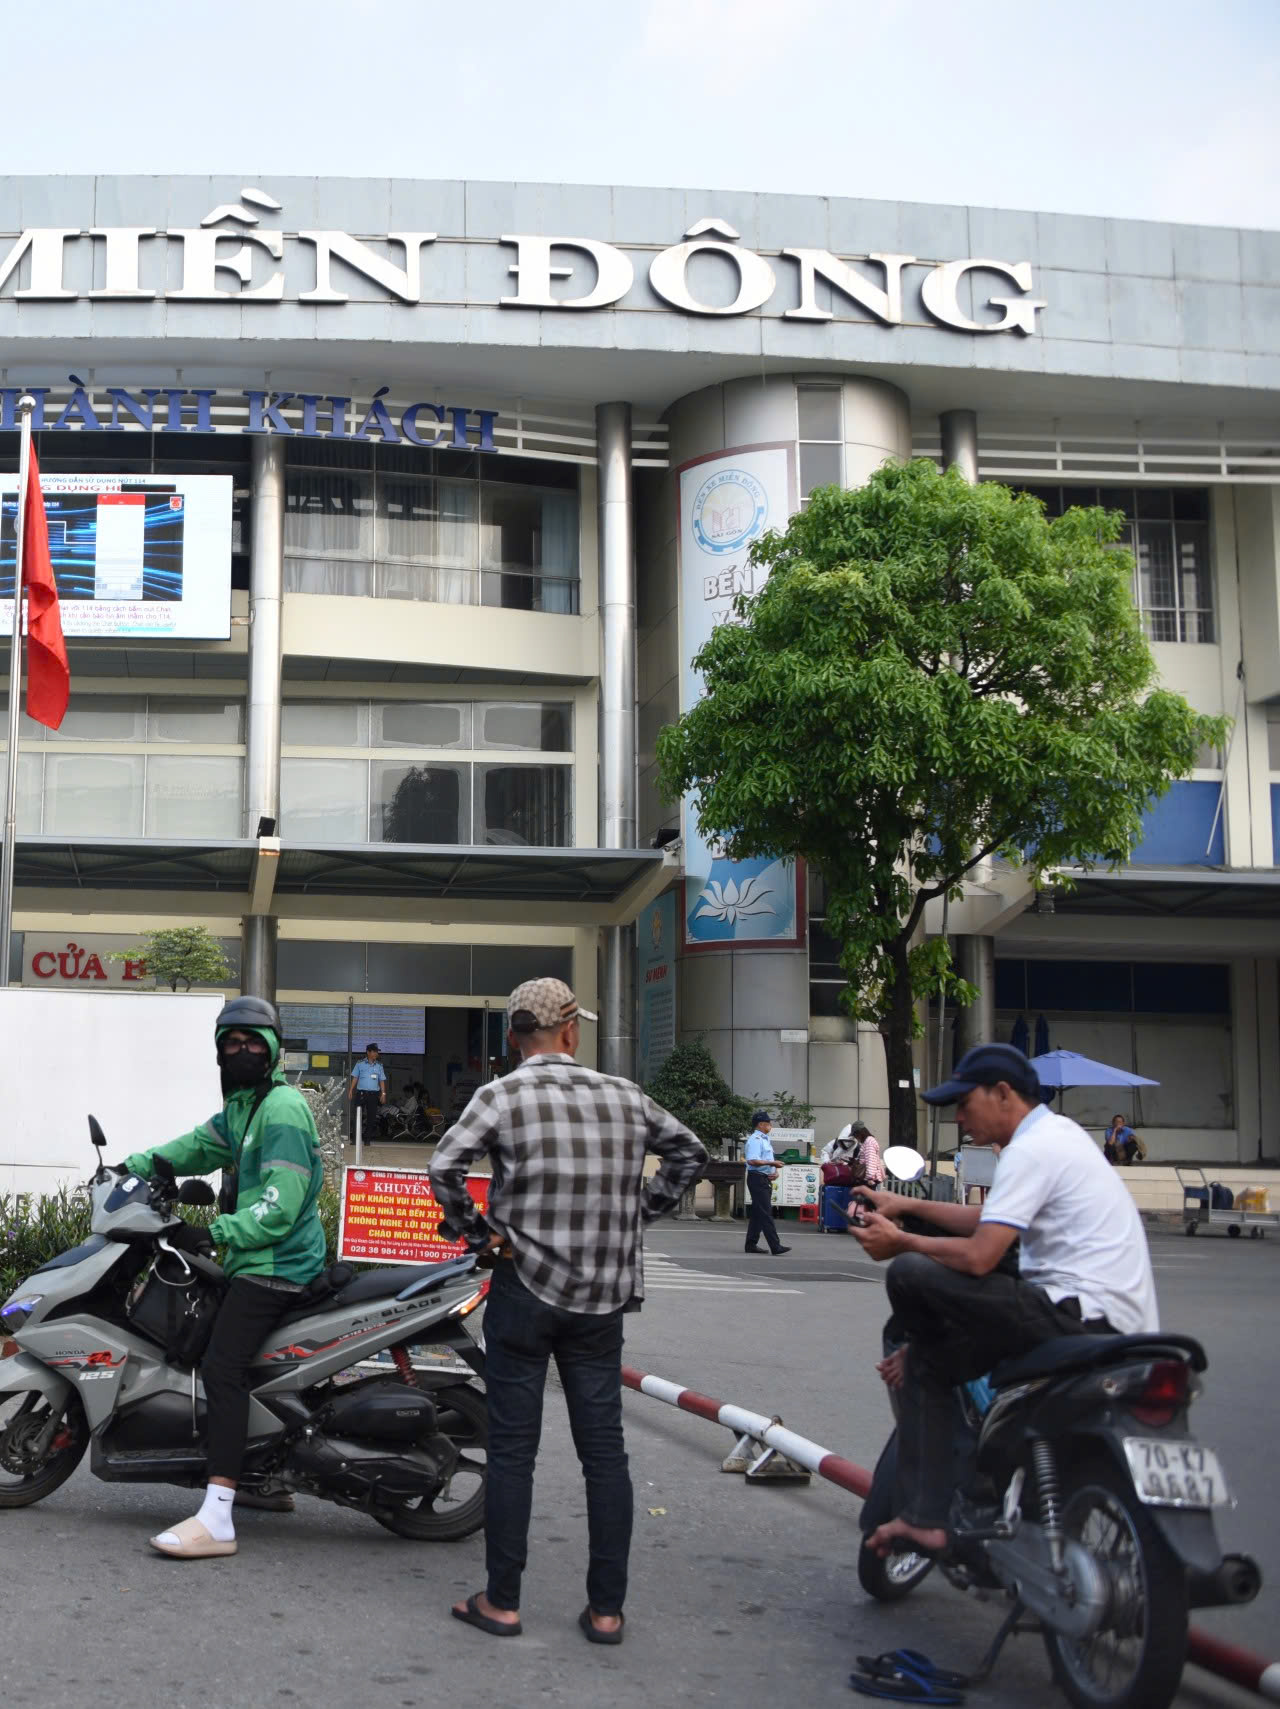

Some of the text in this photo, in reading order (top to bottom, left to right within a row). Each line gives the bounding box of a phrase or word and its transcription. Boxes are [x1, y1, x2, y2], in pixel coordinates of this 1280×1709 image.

[499, 218, 1048, 336] ĐÔNG
[243, 386, 500, 453] KHÁCH
[704, 564, 754, 601] BẾN
[31, 943, 108, 979] CỬA
[374, 1181, 431, 1196] KHUYẾN
[367, 1194, 395, 1204] KHÁCH
[396, 1197, 410, 1205] VUI
[350, 1205, 376, 1215] TRONG
[378, 1206, 395, 1216] NHÀ
[396, 1208, 407, 1216] GA
[427, 1211, 438, 1219] XE
[348, 1215, 377, 1226] KHÔNG
[380, 1219, 403, 1227] NGHE
[351, 1245, 367, 1253] 028
[381, 1247, 397, 1255] 984
[398, 1248, 414, 1256] 441
[420, 1250, 440, 1258] 1900
[441, 1251, 457, 1259] 571
[79, 1370, 116, 1381] 125
